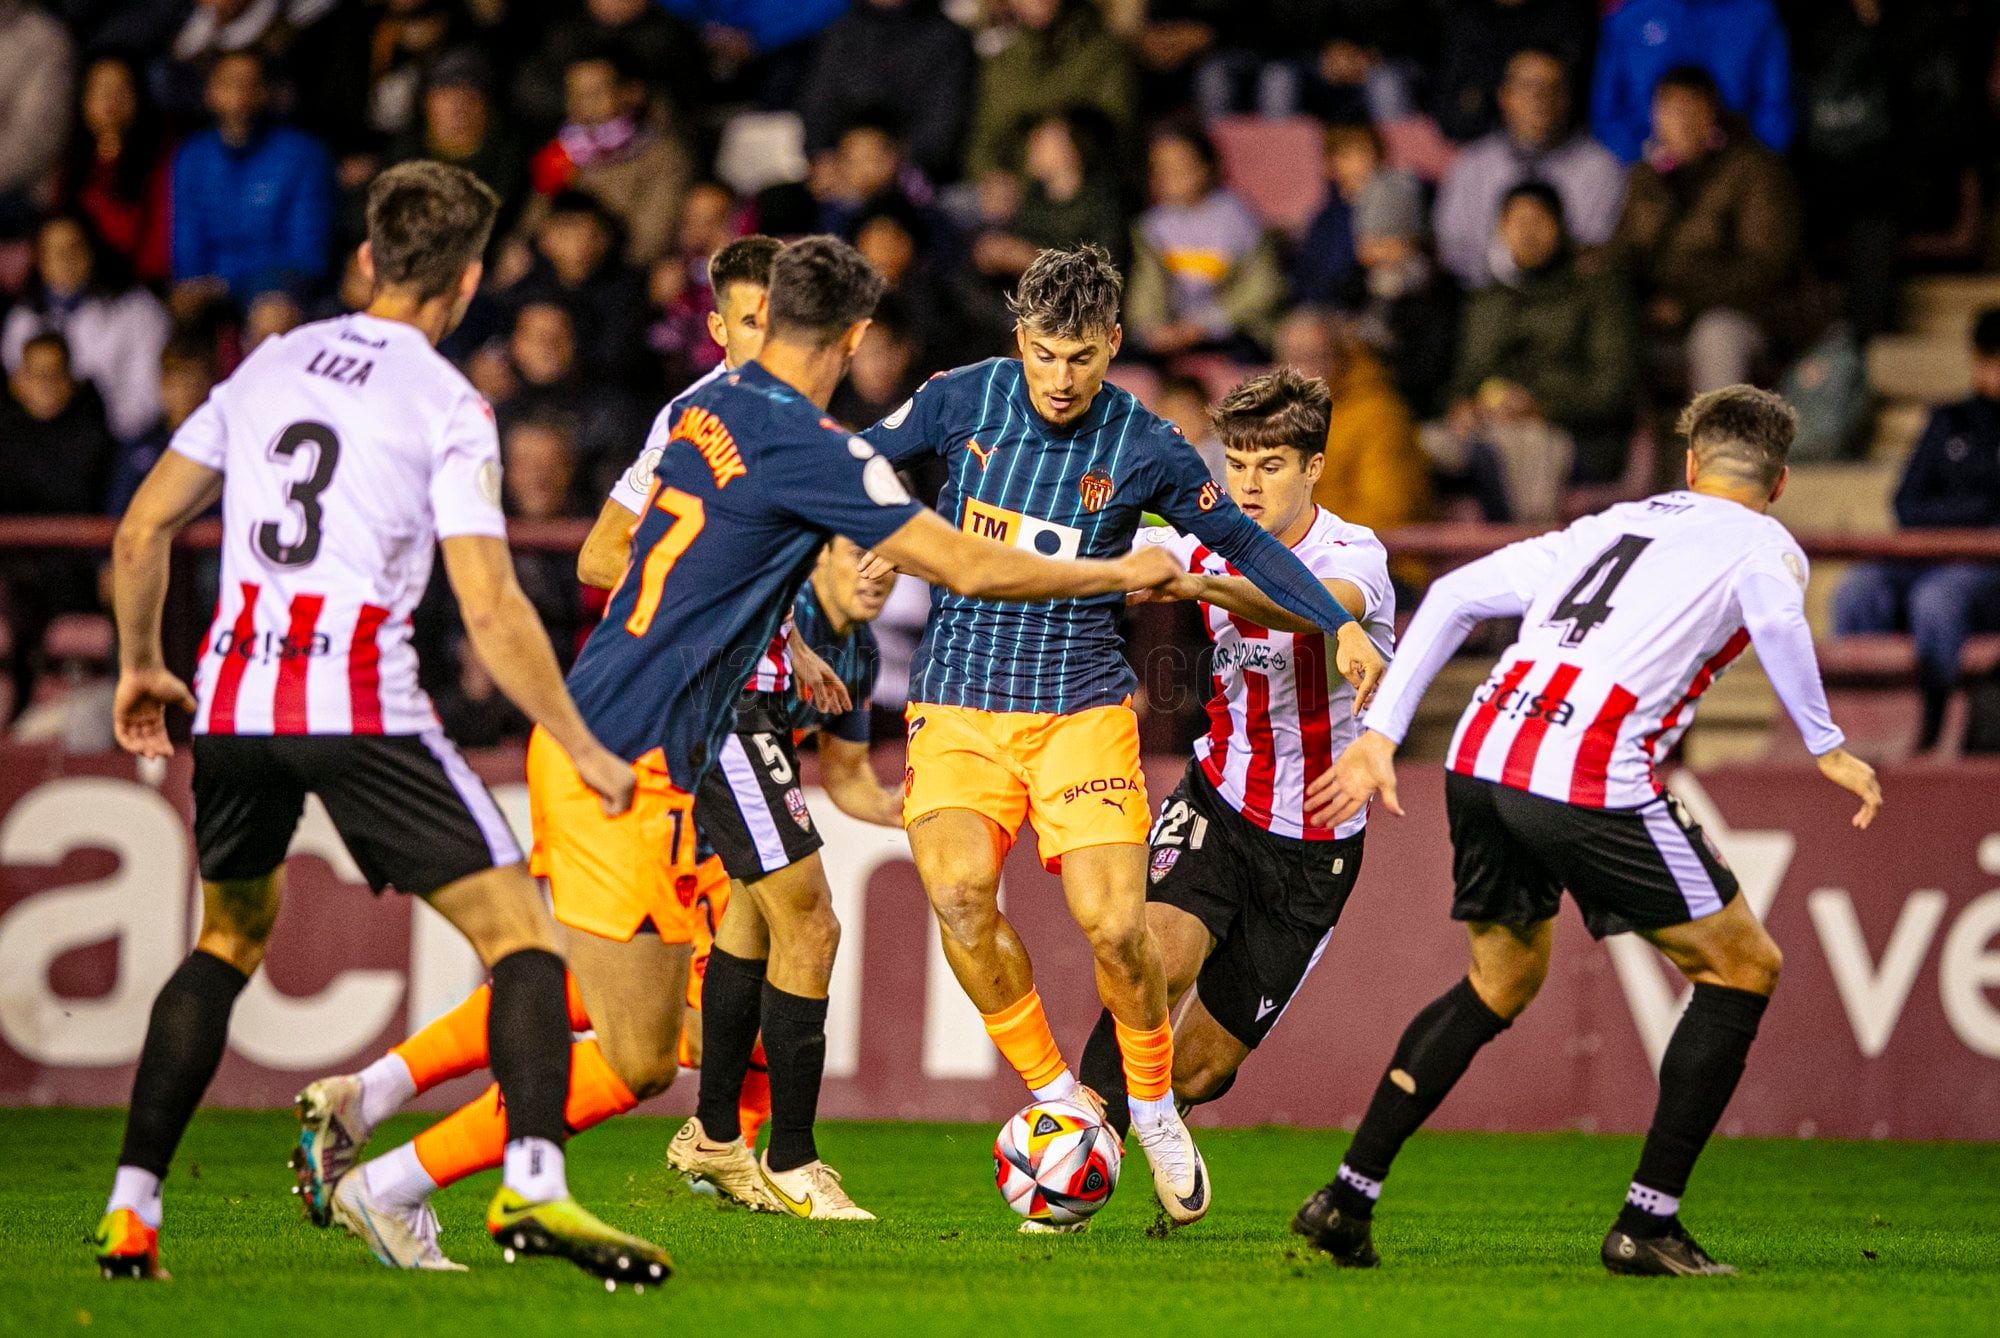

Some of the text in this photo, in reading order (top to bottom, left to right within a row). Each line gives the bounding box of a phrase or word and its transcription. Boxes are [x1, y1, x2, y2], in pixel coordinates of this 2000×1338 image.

[306, 349, 375, 386] LIZA
[250, 419, 341, 573] 3
[972, 510, 1009, 542] TM
[1540, 532, 1656, 649] 4
[752, 733, 793, 785] 5
[1153, 799, 1209, 850] 21
